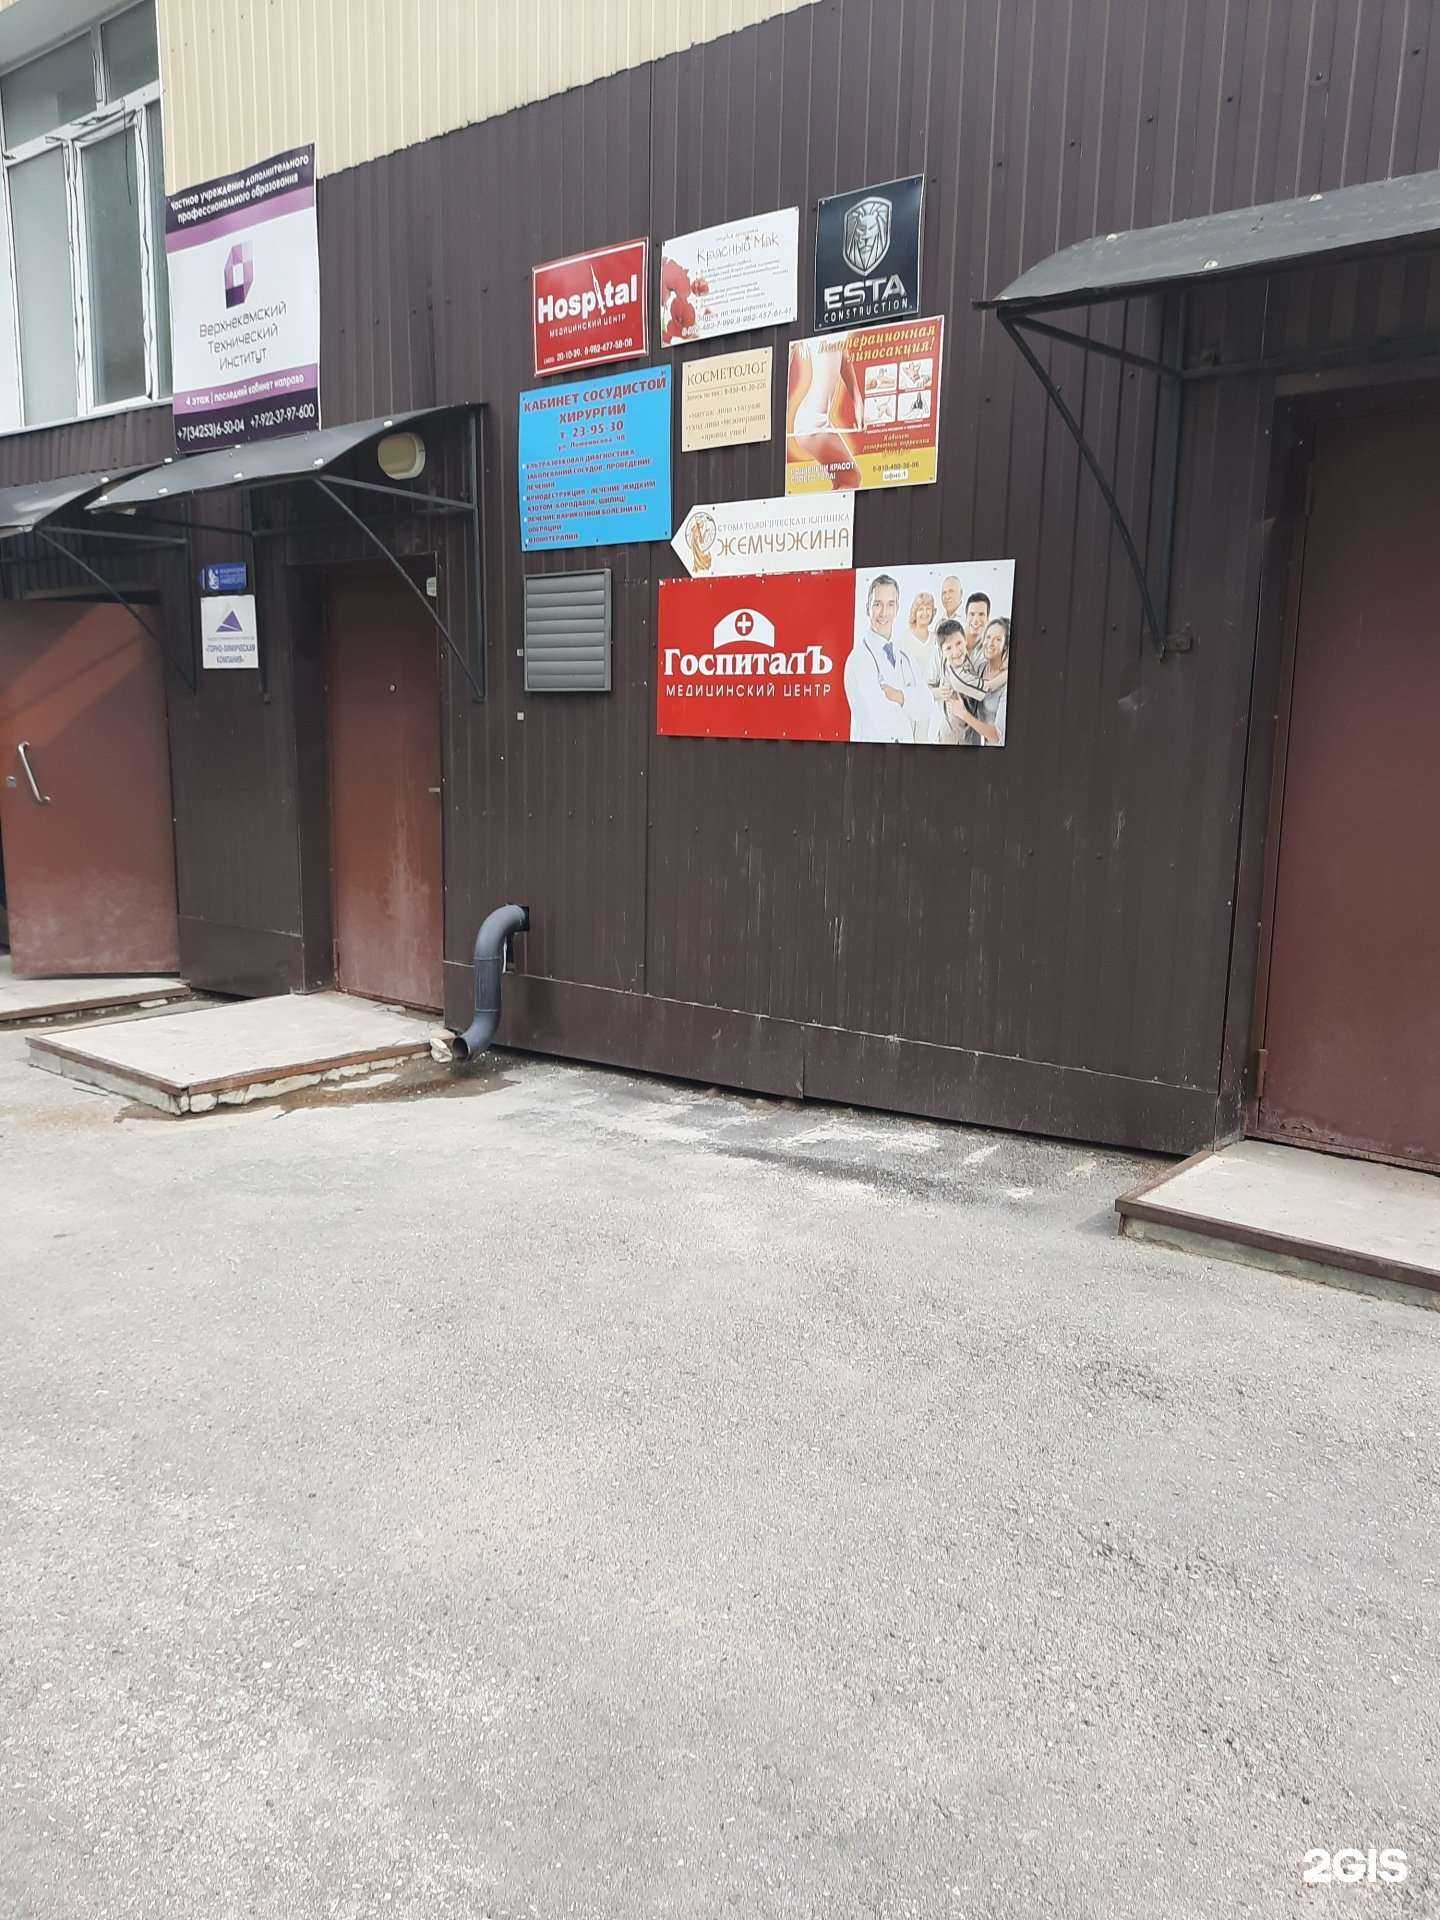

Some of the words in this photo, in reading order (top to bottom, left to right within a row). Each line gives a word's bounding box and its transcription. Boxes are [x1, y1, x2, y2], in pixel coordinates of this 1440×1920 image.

[200, 178, 245, 204] учреждение
[246, 155, 309, 188] дополнительного
[177, 191, 251, 224] профессионального
[251, 173, 298, 198] образования
[753, 231, 781, 249] Мак
[824, 274, 906, 309] ESTA
[199, 301, 287, 339] Верхнекамский
[824, 297, 908, 323] CONSTRUCTION
[208, 323, 278, 354] Технический
[549, 317, 602, 339] МЕДИЦИНСКИЙ
[604, 312, 626, 326] ЦЕНТР
[220, 348, 266, 371] Институт
[847, 338, 935, 364] липосакция!
[687, 361, 767, 387] КОСМЕТОЛОГ
[214, 385, 247, 402] последний
[274, 374, 304, 389] направо
[524, 393, 580, 412] КАБИНЕТ
[583, 376, 666, 402] СОСУДИСТОЙ
[559, 403, 626, 424] ХИРУРГИИ
[585, 449, 635, 463] ДИАГНОСТИКА
[606, 458, 651, 470] ПРОВЕДЕНИЕ
[622, 480, 656, 491] ЖИДКИМ
[601, 506, 633, 516] БОЛЕЗНИ
[718, 516, 807, 533] СТОМАТОЛОГИЧЕСКАЯ
[808, 512, 850, 524] КЛИНИКА
[717, 527, 849, 556] ЖЕМЧУЖИНА
[666, 682, 775, 697] МЕДИЦИНСКИЙ
[784, 684, 831, 697] ЦЕНТР
